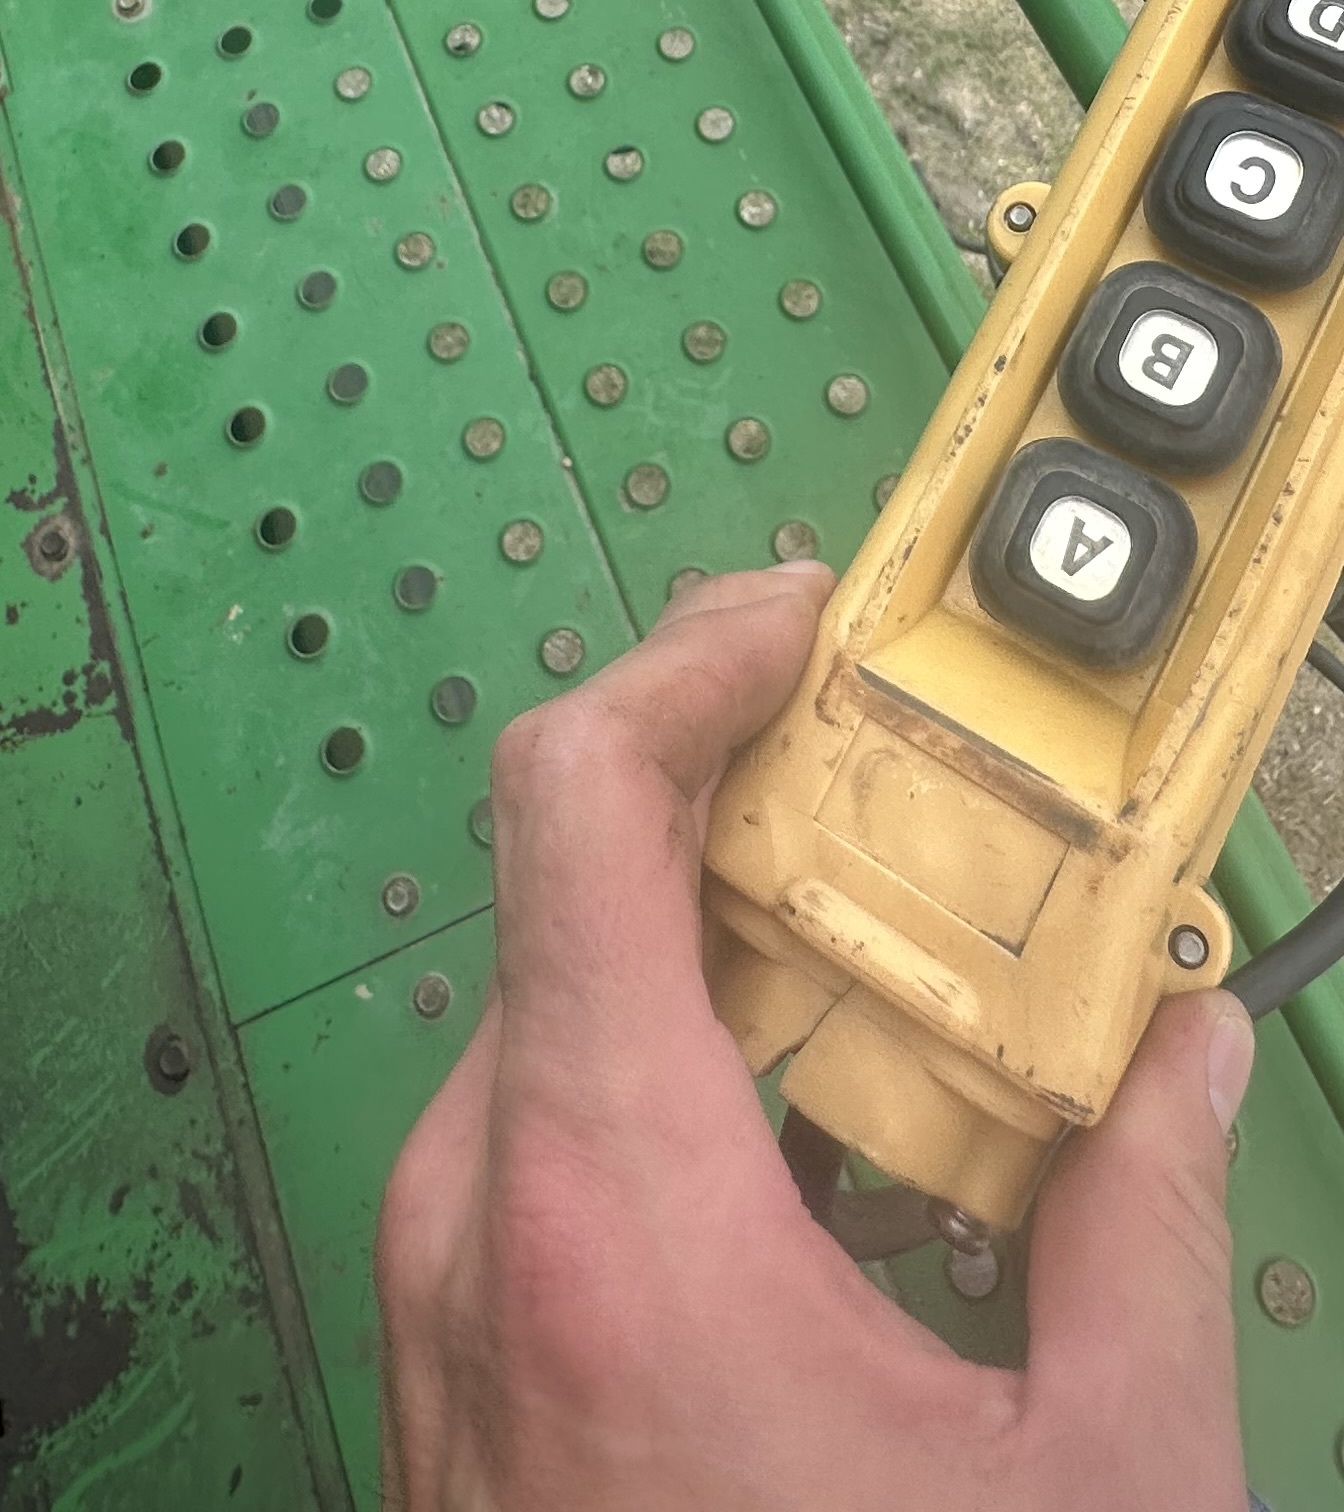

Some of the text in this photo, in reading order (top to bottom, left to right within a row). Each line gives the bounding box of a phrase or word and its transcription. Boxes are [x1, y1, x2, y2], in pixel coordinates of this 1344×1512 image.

[1229, 156, 1277, 205] C
[1141, 333, 1195, 391] B
[1060, 515, 1115, 577] A
